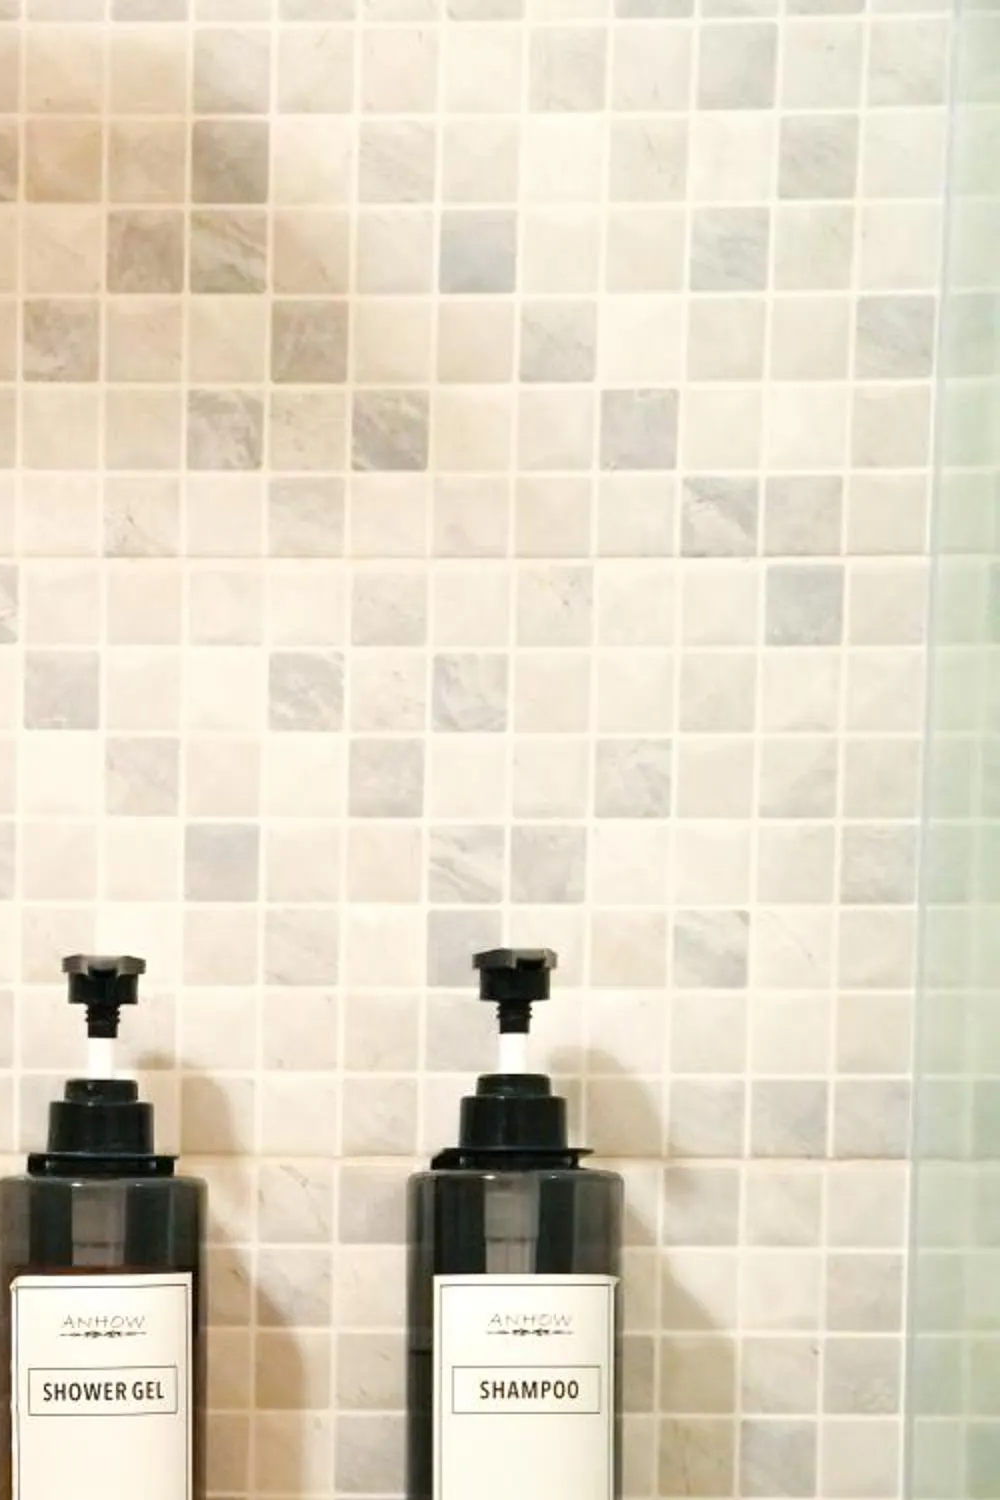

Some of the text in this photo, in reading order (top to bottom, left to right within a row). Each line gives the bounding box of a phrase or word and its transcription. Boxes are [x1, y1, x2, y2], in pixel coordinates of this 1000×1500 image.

[62, 1315, 146, 1328] ANHOW
[488, 1313, 573, 1327] ANHOW
[43, 1381, 165, 1401] SHOWER GEL
[480, 1380, 579, 1400] SHAMPOO
